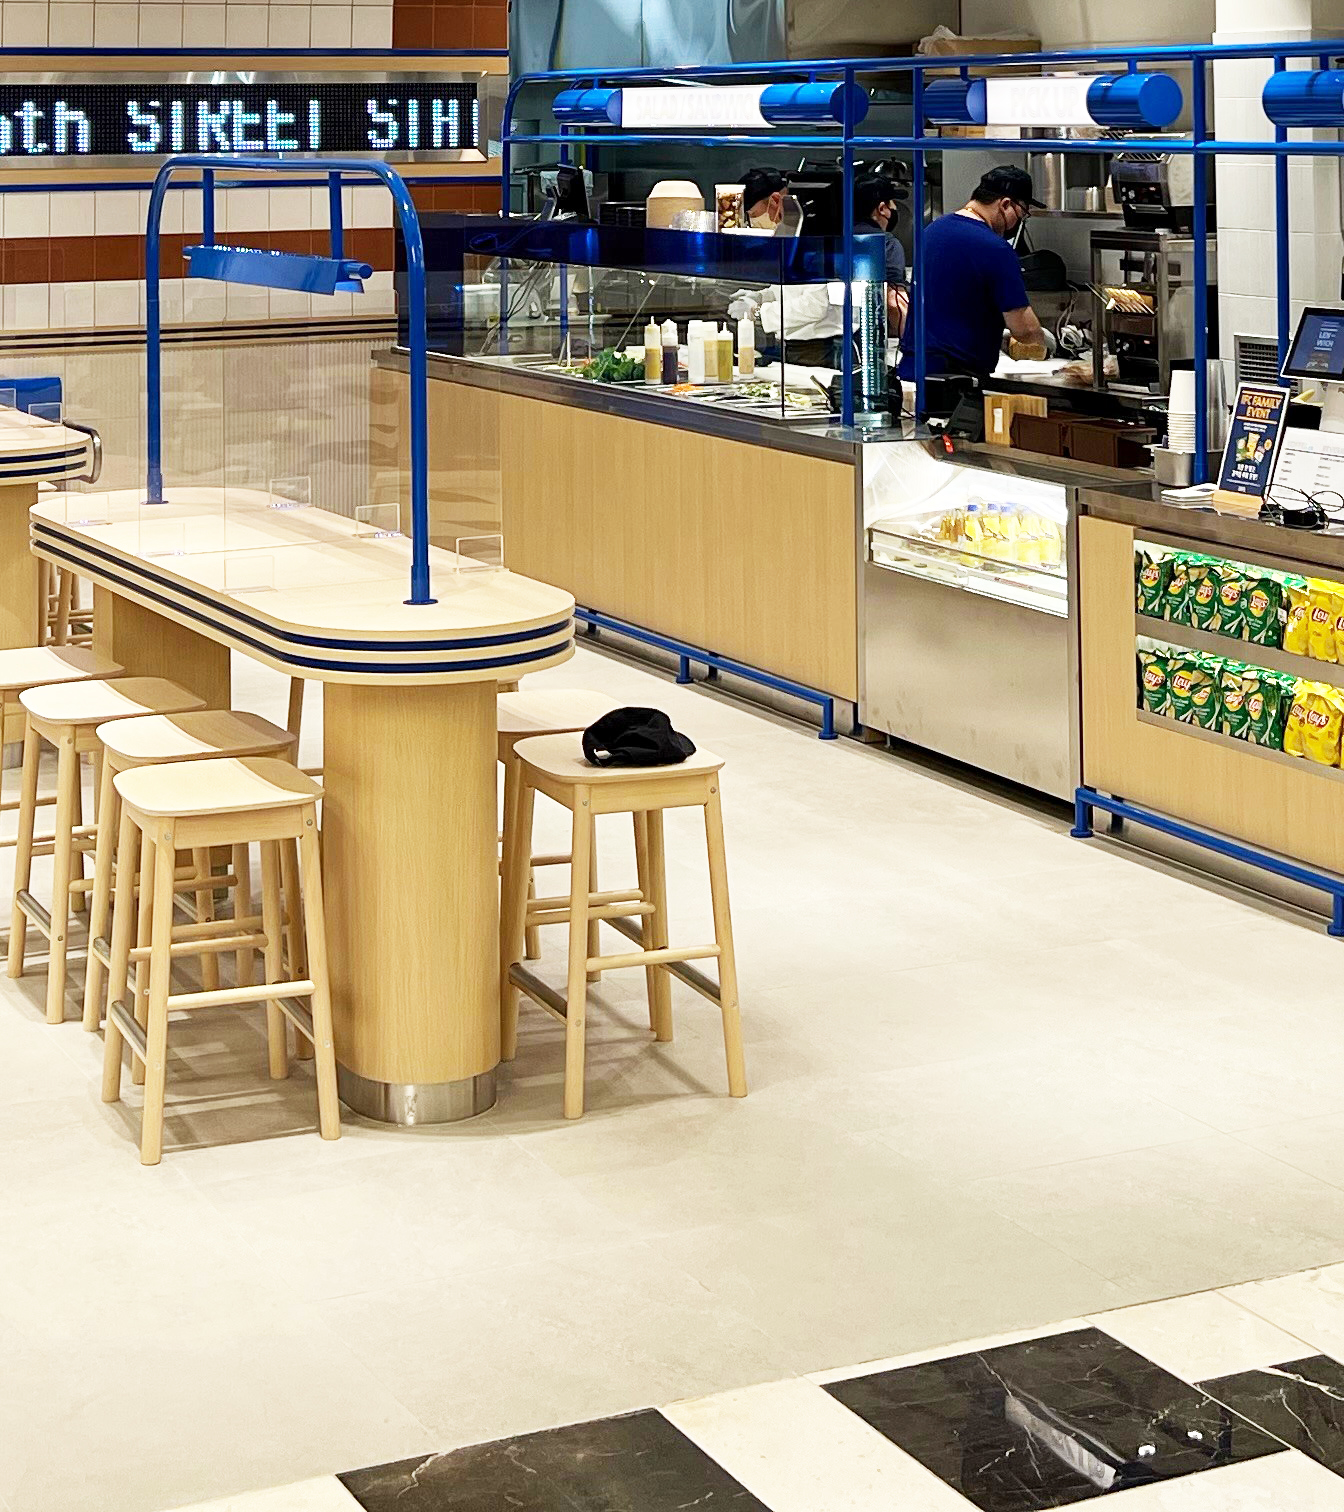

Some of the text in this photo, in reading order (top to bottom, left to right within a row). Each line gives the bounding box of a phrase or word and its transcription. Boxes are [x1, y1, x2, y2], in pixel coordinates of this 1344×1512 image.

[1010, 85, 1079, 118] PICK UP
[1251, 396, 1281, 409] FAMILY
[1246, 407, 1271, 419] EVENT
